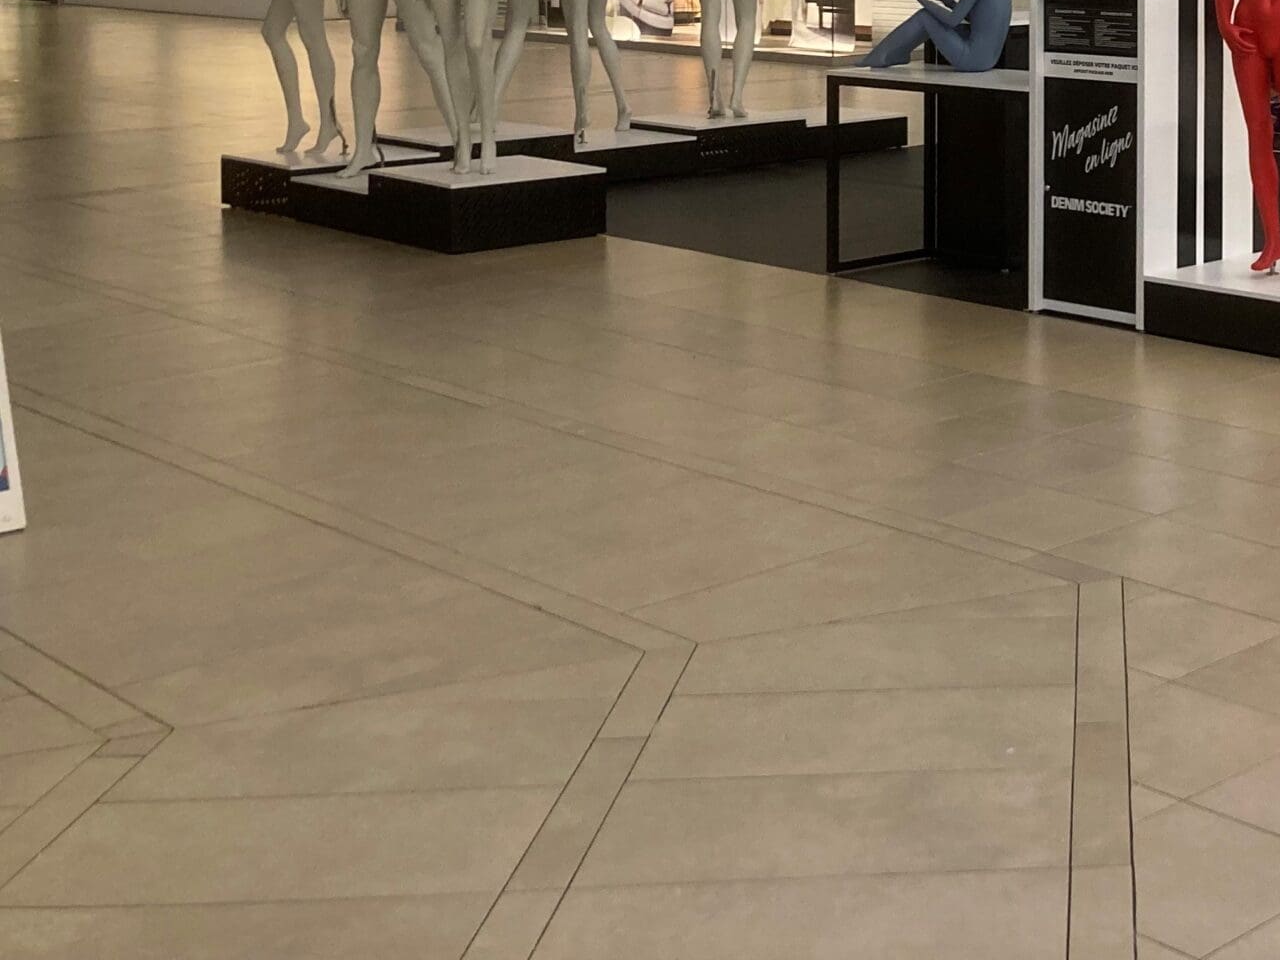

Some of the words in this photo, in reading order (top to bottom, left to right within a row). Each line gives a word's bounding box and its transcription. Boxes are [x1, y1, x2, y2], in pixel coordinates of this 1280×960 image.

[1051, 105, 1119, 160] Magasinez
[1085, 154, 1101, 173] en
[1101, 131, 1133, 168] ligne
[1051, 195, 1085, 212] DENIM
[1085, 200, 1129, 218] SOCIETY
